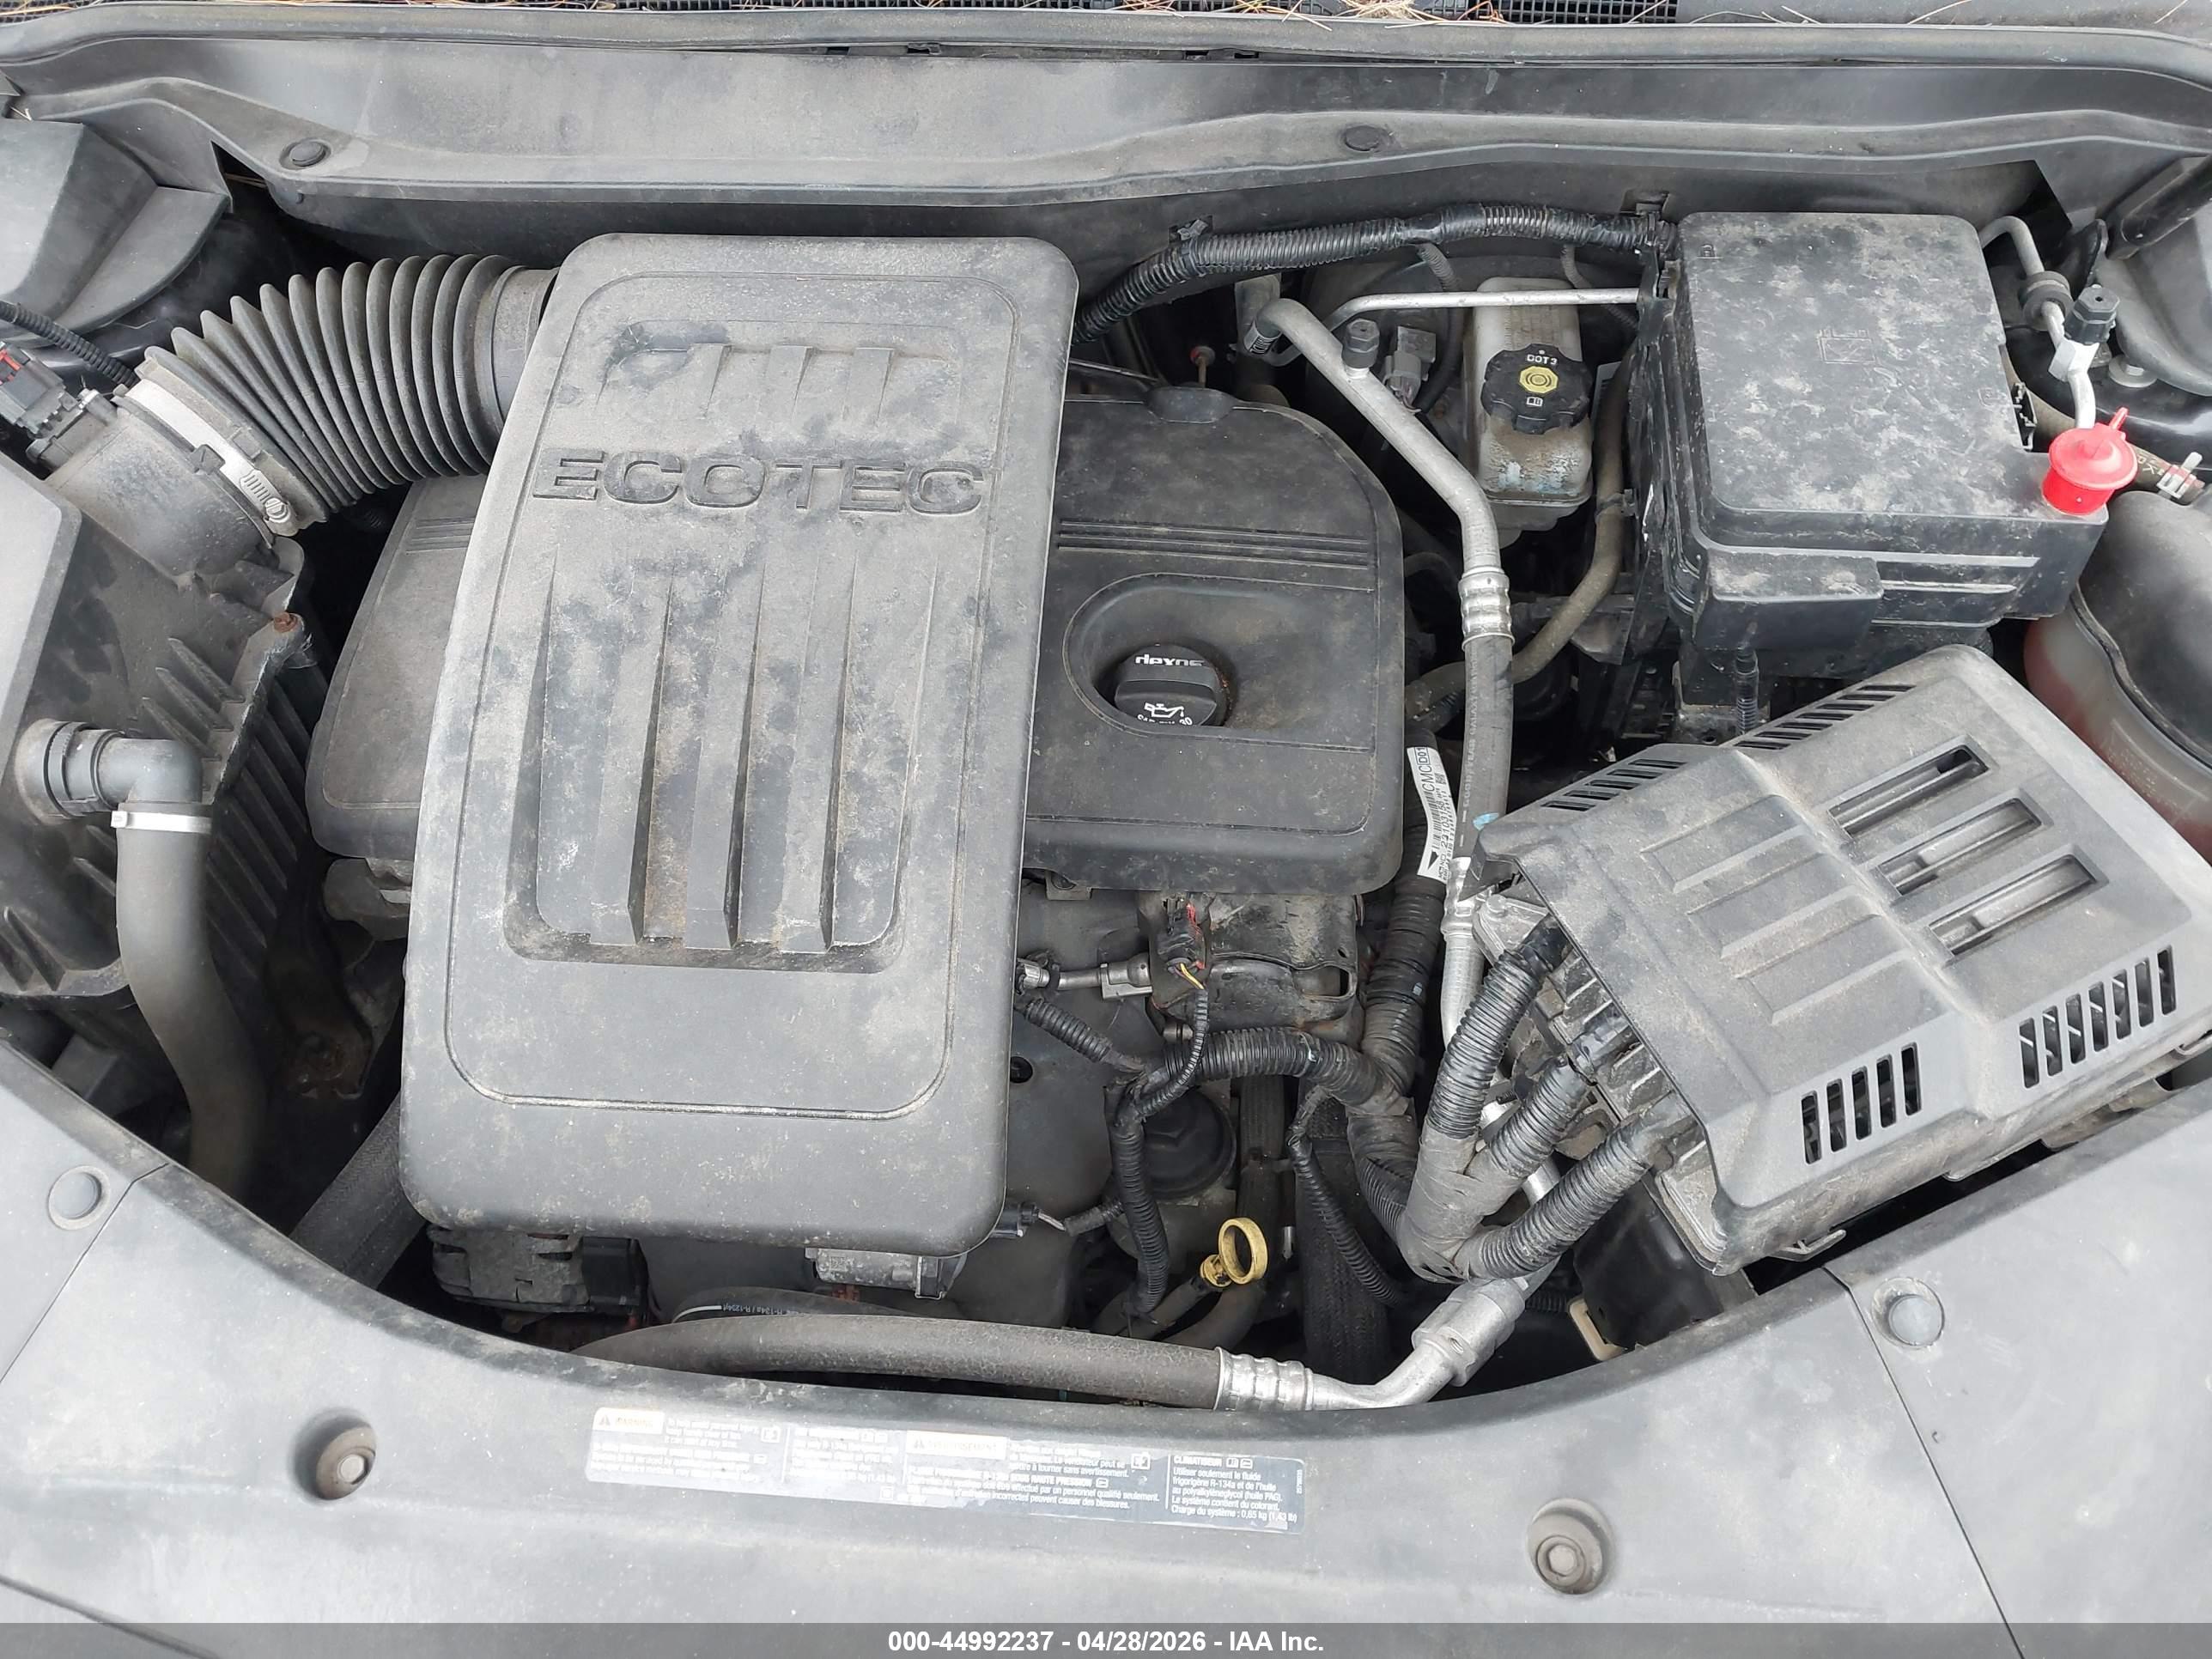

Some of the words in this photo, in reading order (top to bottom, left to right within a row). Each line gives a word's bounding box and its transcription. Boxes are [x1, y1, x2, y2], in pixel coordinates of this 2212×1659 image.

[1527, 354, 1549, 364] DOT
[532, 448, 984, 515] ECOTEC
[1419, 765, 1435, 793] CMC
[1174, 1468, 1196, 1476] Utiliser
[1198, 1469, 1232, 1479] seulement
[1242, 1472, 1261, 1480] fluide
[1210, 1480, 1235, 1489] R-134a
[1063, 1488, 1096, 1498] personnel
[1170, 1506, 1195, 1516] Charge
[1258, 1512, 1267, 1521] kg
